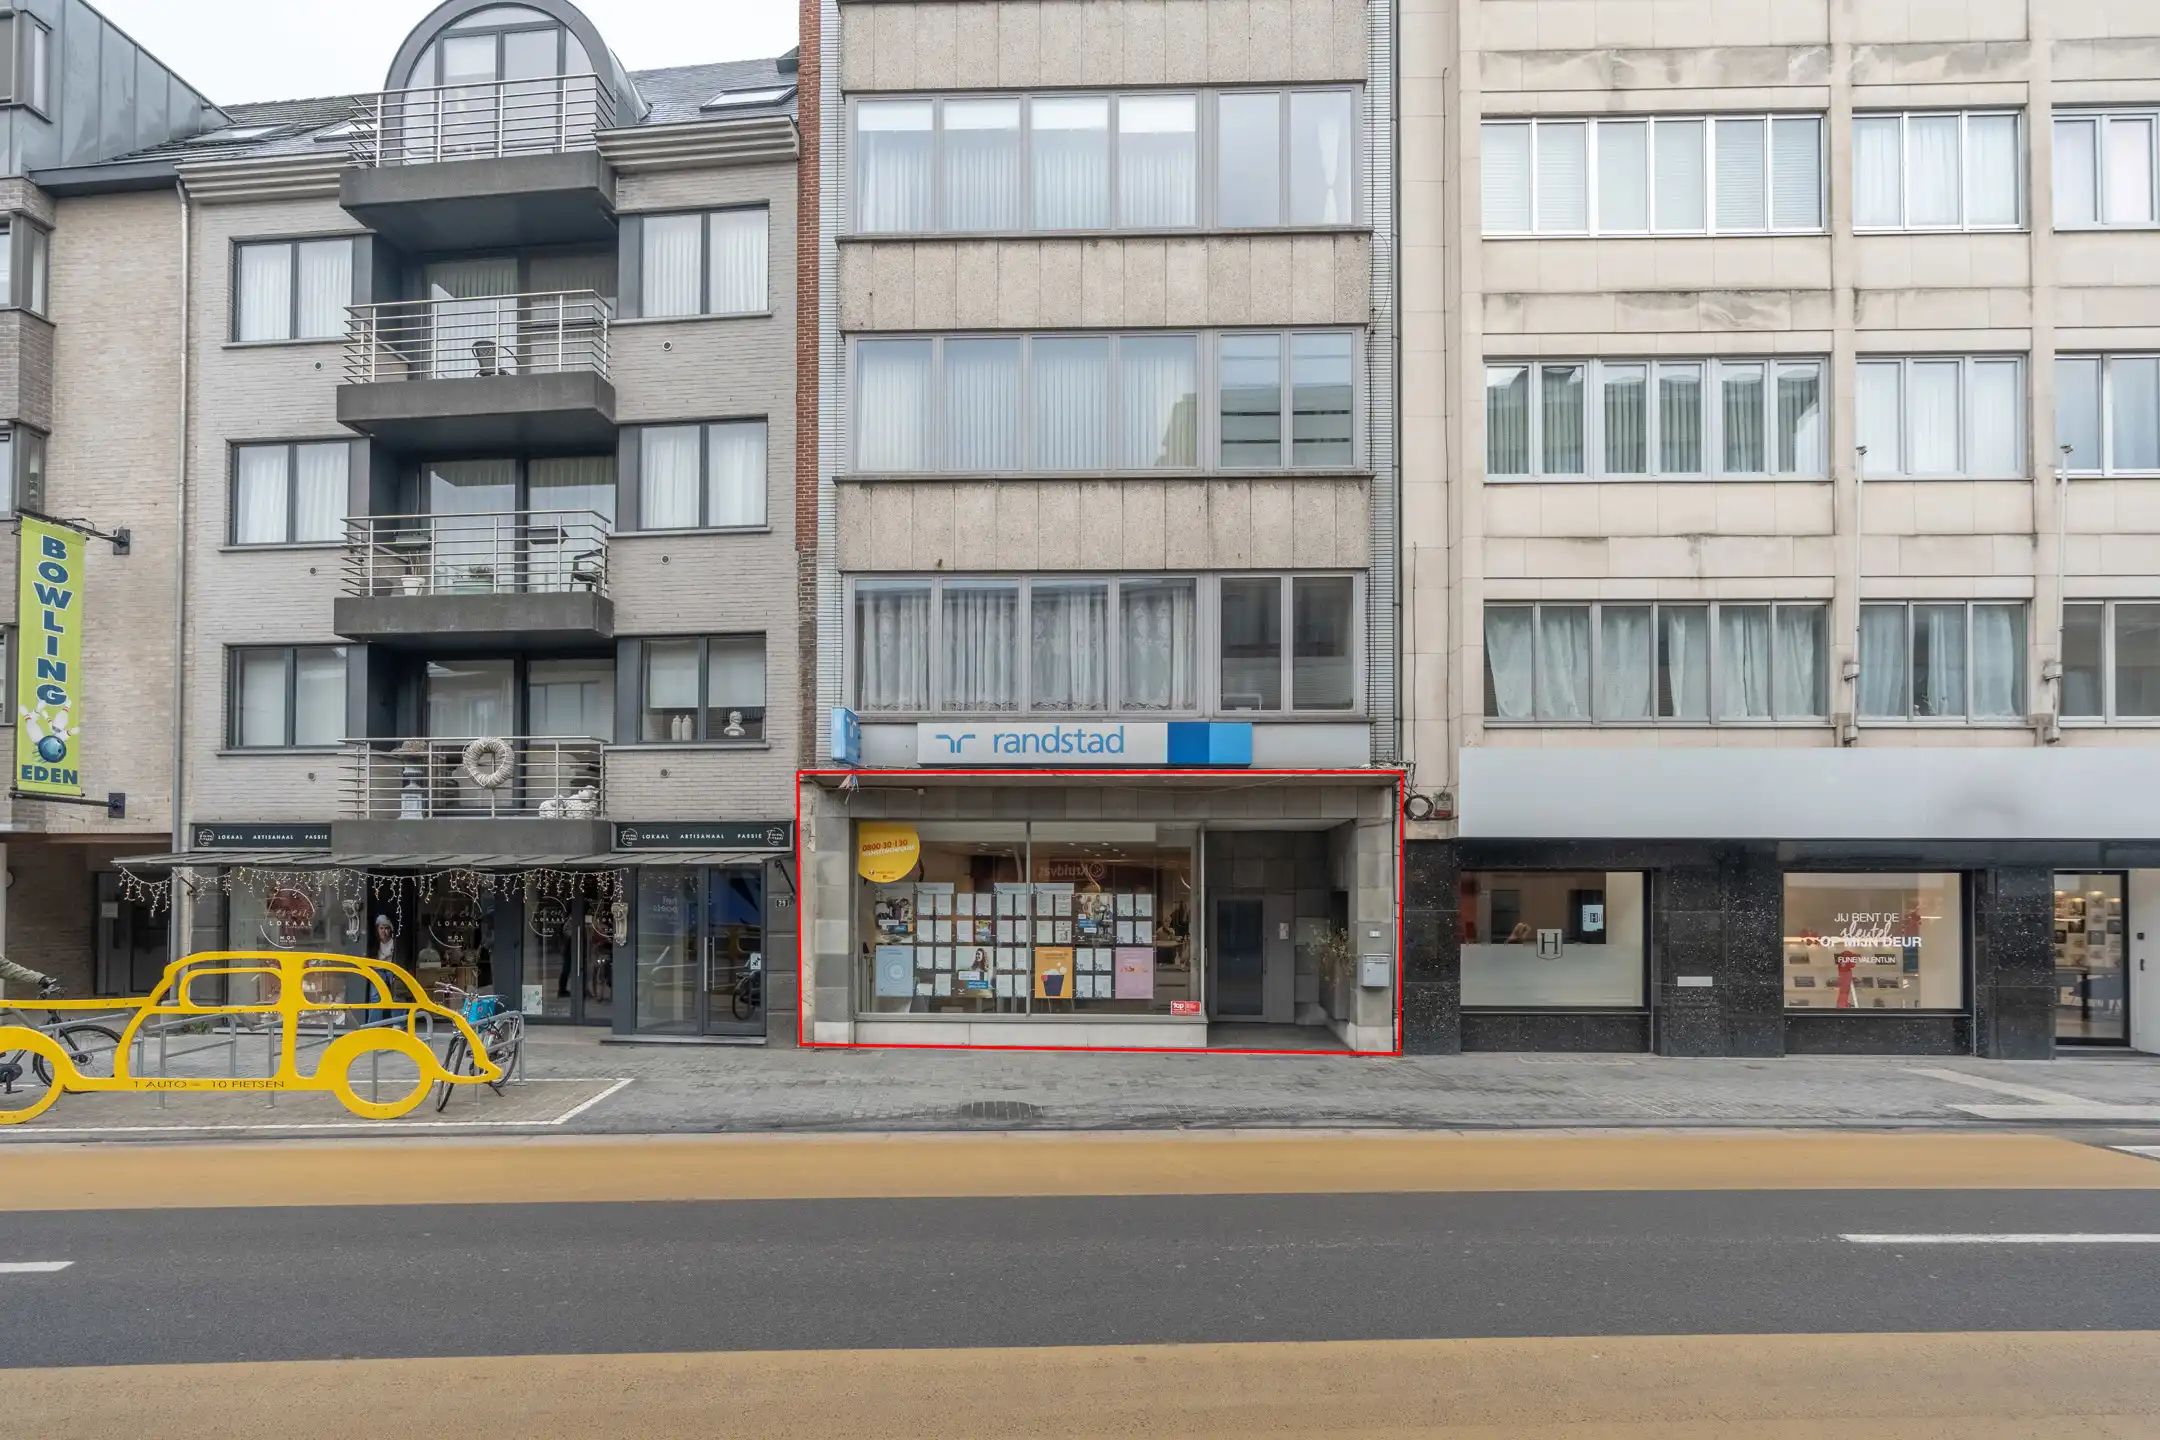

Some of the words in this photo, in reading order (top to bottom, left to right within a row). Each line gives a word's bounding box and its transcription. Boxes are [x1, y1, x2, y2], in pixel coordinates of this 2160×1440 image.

[32, 533, 73, 706] BOWLING
[993, 725, 1125, 754] randstad
[21, 764, 78, 785] EDEN
[1834, 912, 1849, 922] JIJ
[1852, 912, 1881, 922] BENT
[1884, 912, 1900, 922] DE
[1840, 920, 1893, 939] sleutel
[1540, 932, 1560, 955] H
[1820, 936, 1840, 947] OP
[1844, 937, 1879, 947] MIJN
[1883, 936, 1922, 947] DEUR
[145, 1080, 187, 1088] AUTO
[211, 1080, 228, 1088] 10
[231, 1080, 285, 1088] FIETSEN
